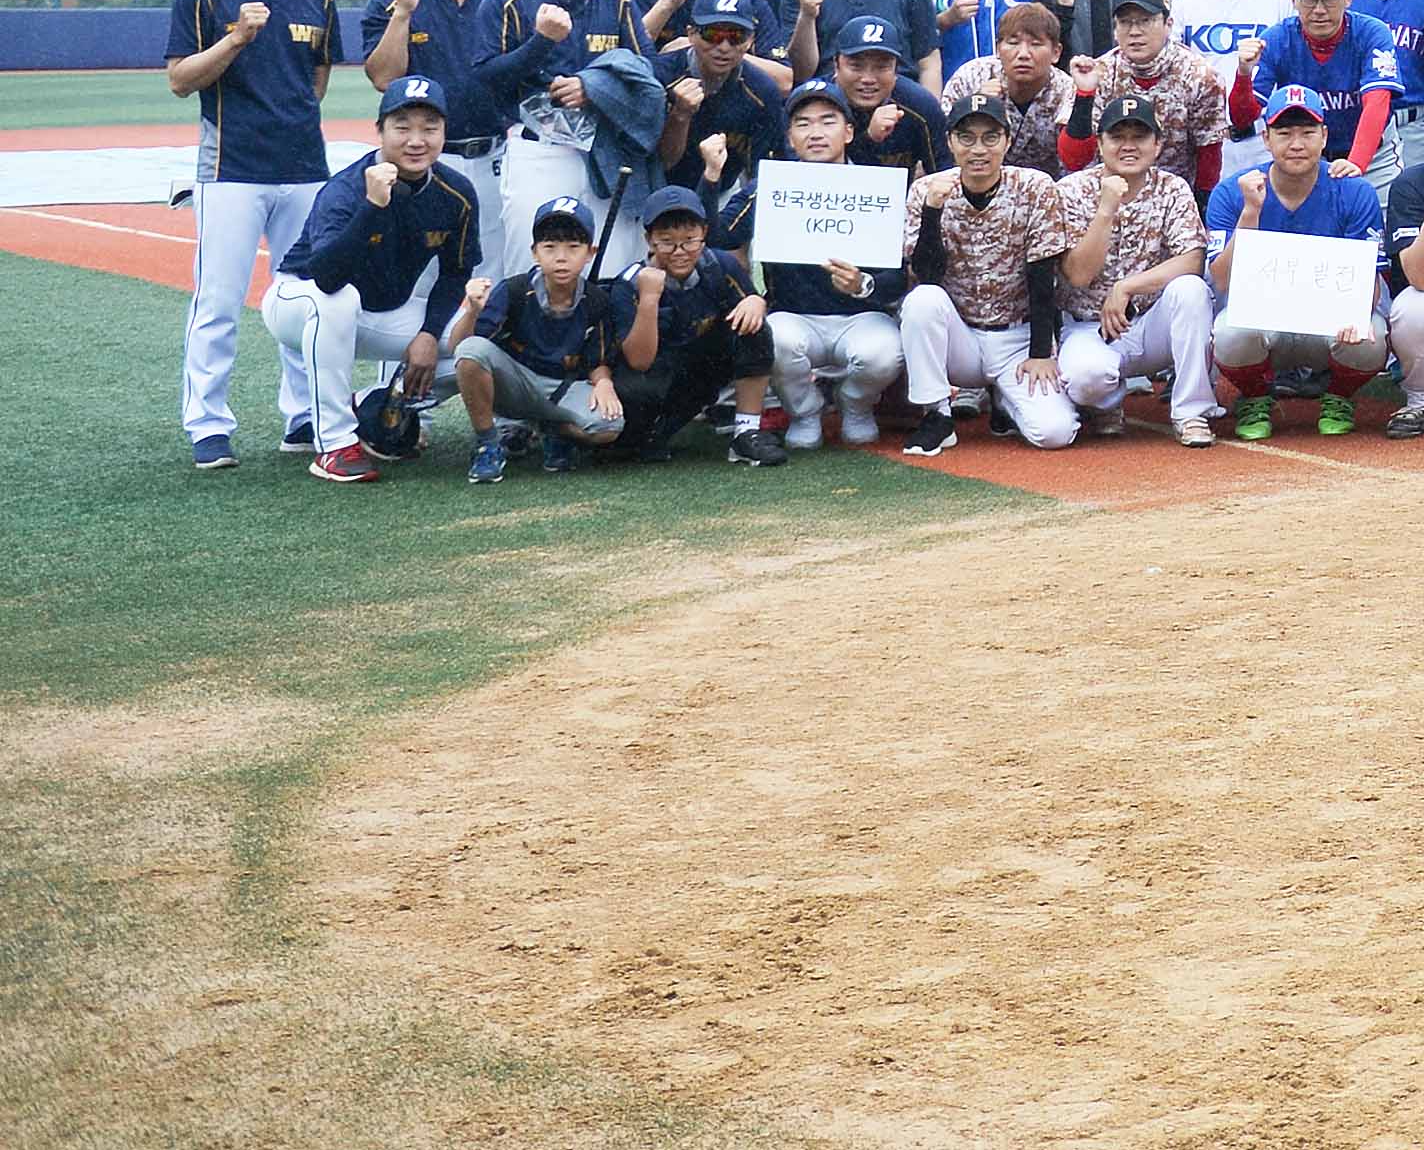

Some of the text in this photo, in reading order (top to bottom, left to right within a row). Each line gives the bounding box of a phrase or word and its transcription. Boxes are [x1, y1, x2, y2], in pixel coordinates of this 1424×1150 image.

[971, 96, 986, 111] P
[1123, 100, 1137, 115] P
[771, 190, 892, 214] 한국생산성본부
[805, 217, 854, 236] (KPC)
